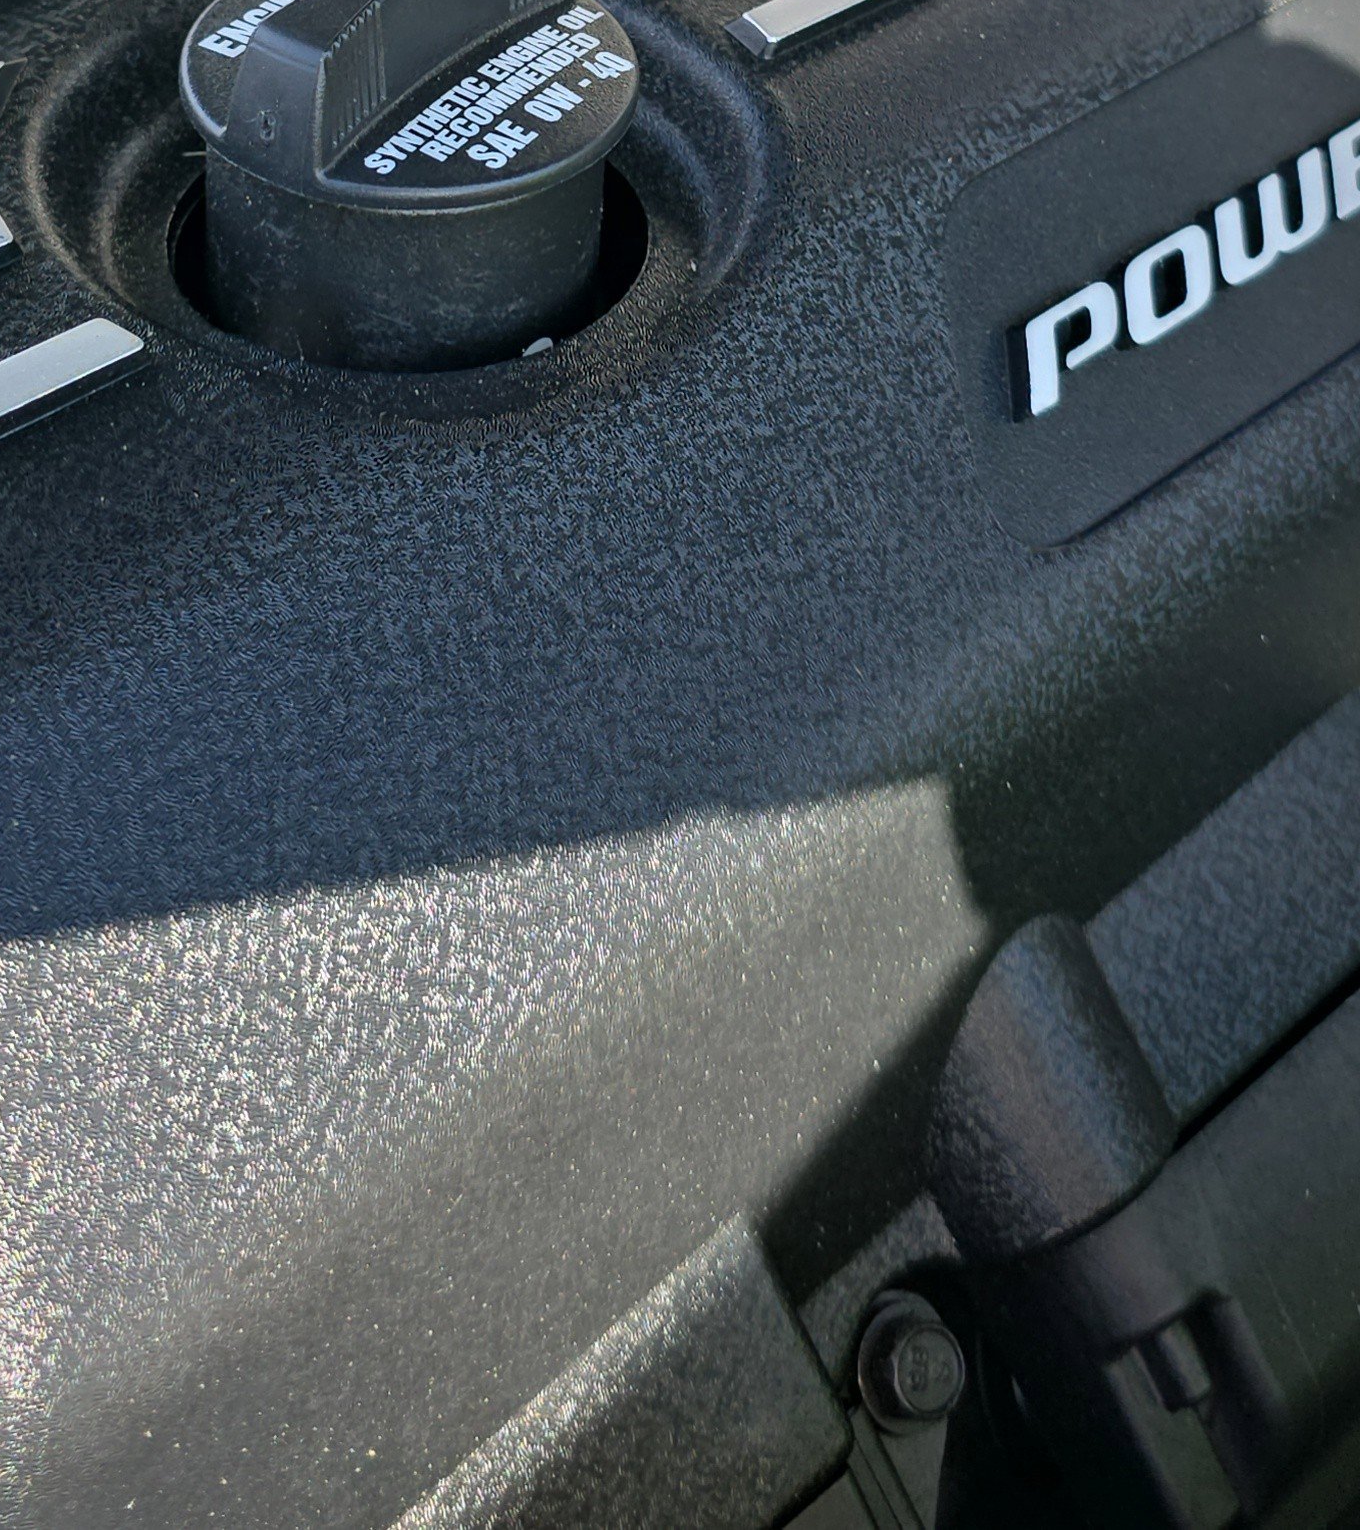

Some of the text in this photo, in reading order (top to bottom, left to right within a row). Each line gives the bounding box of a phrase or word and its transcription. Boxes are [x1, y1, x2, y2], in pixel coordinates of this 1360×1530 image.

[364, 5, 605, 175] SYNTHETIC ENGINE OIL
[419, 32, 601, 162] RECOMMENDED
[466, 120, 539, 169] SAE
